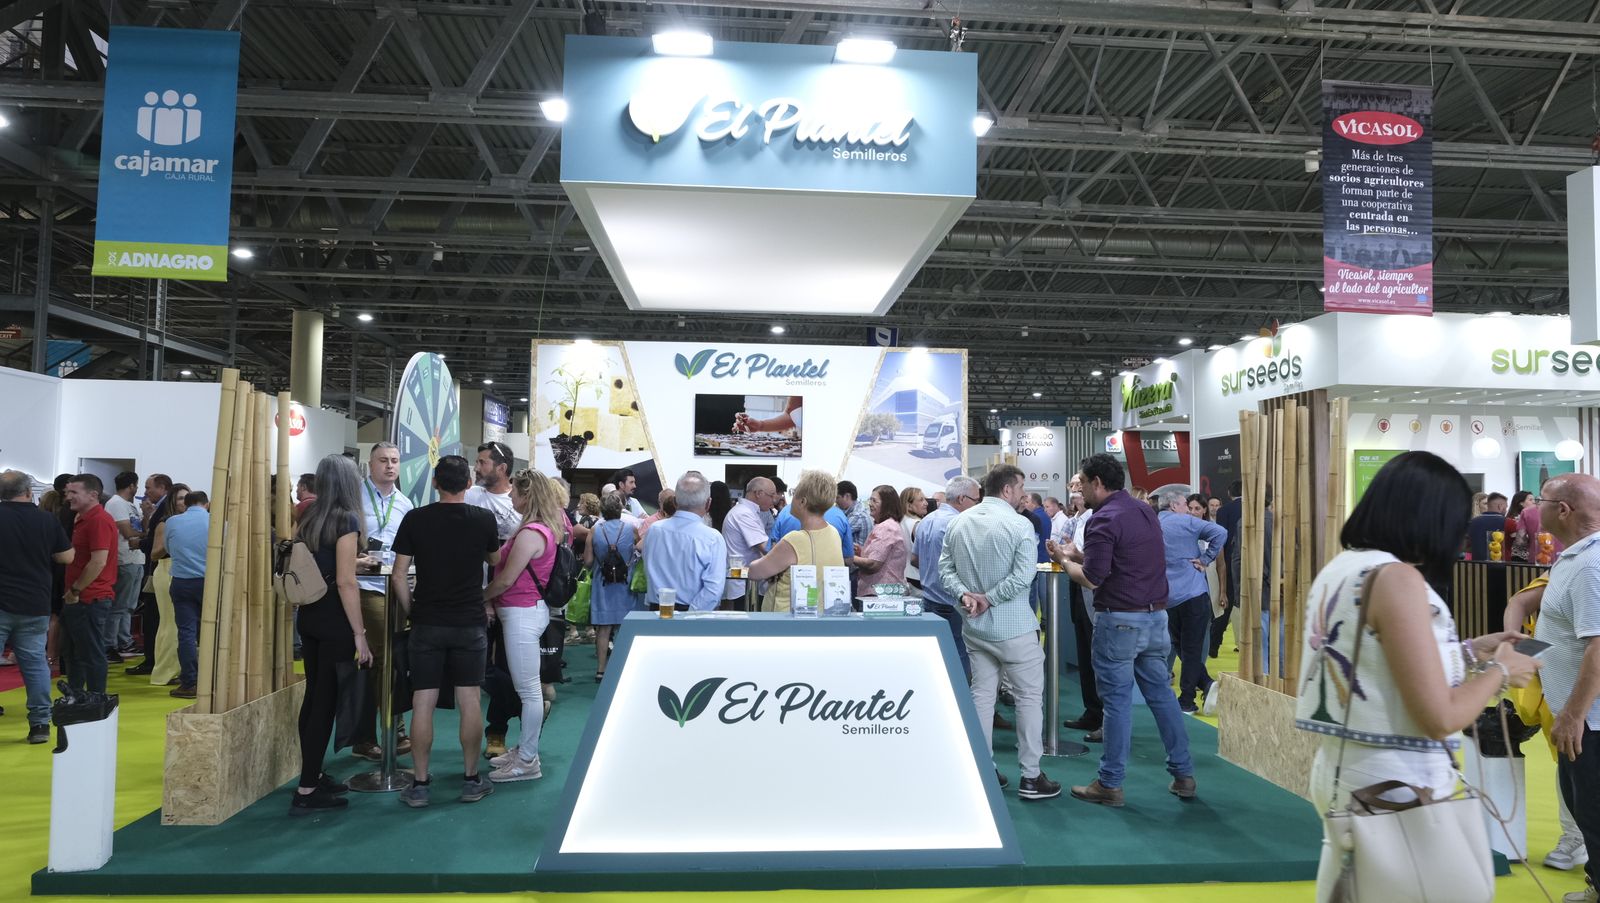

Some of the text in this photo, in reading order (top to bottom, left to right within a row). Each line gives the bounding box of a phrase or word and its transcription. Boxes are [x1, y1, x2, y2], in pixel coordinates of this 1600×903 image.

[697, 97, 915, 146] El Plantel
[1338, 118, 1418, 138] VICASOL
[832, 147, 908, 162] Semilleros
[1351, 149, 1404, 163] Más de tres
[114, 150, 219, 177] cajamar
[1341, 163, 1414, 175] generaciones de
[164, 173, 216, 182] CAJA RURAL
[1329, 173, 1425, 188] socios agricultores
[1341, 184, 1413, 199] forman parte de
[1342, 199, 1413, 211] una cooperativa
[1349, 211, 1394, 221] centrada
[1346, 220, 1360, 231] las
[118, 251, 214, 271] ADNAGRO
[1337, 268, 1414, 284] Vicasol, siempre
[1329, 281, 1429, 298] al lado del agricultor
[710, 352, 830, 379] El Plantel
[1220, 349, 1302, 397] surseeds
[785, 378, 827, 386] Semilleros
[1004, 416, 1054, 428] cajamar
[1016, 447, 1038, 456] HOY
[717, 681, 915, 725] El Plantel
[841, 723, 910, 735] Semilleros
